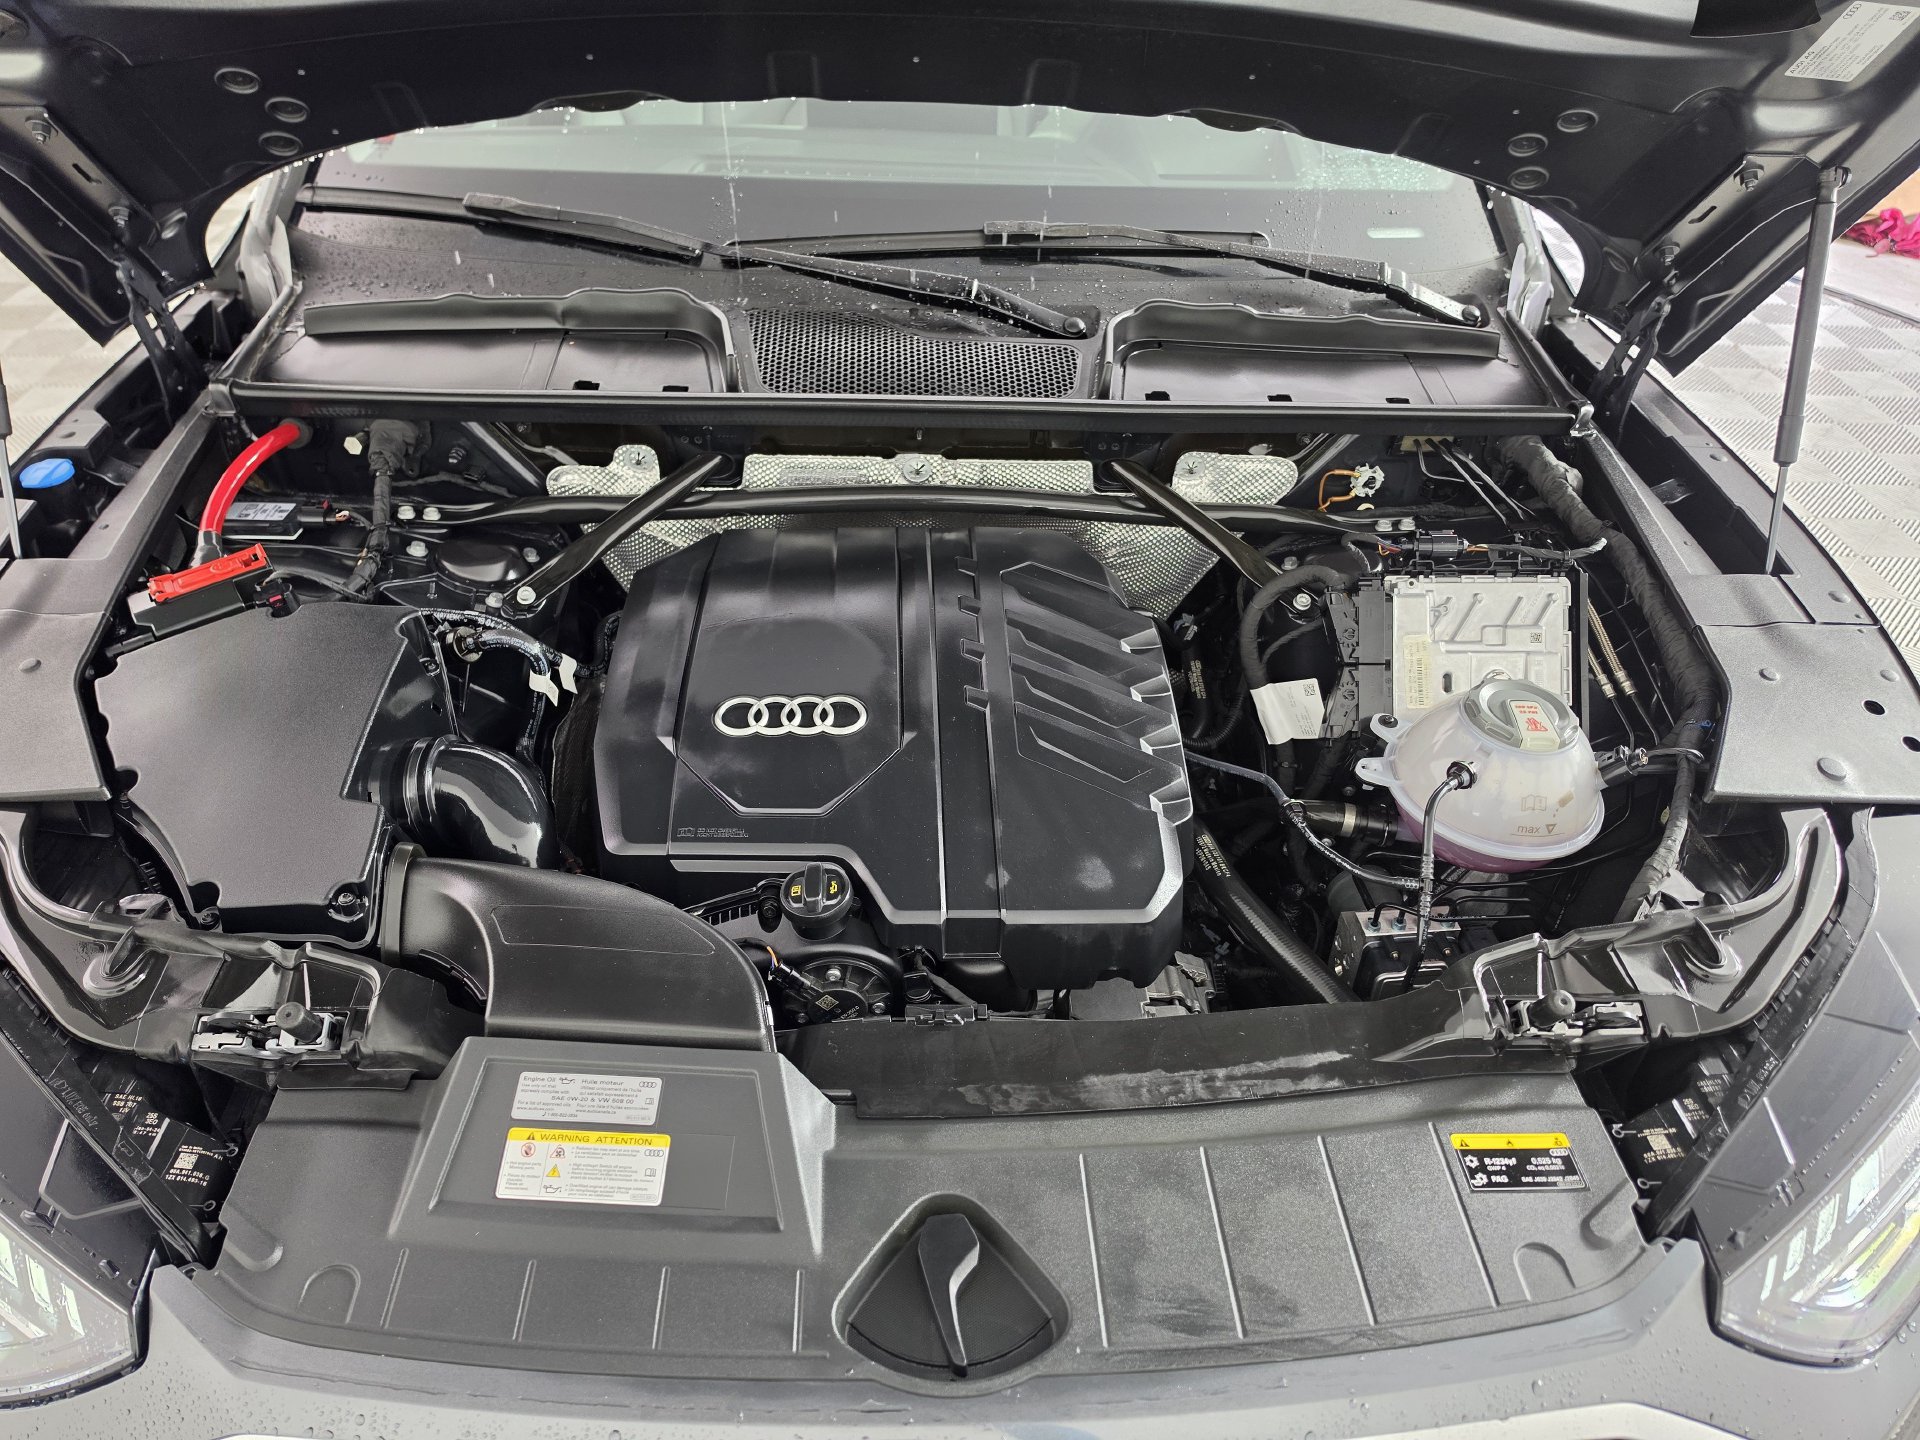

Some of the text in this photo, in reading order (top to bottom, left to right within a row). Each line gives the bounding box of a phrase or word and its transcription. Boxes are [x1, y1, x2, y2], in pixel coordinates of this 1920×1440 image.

[1517, 825, 1540, 834] max
[540, 1134, 653, 1146] WARNING ATTENTION
[1484, 1157, 1517, 1166] R-1234yf
[1552, 1158, 1563, 1166] kg
[1491, 1175, 1509, 1183] PAG
